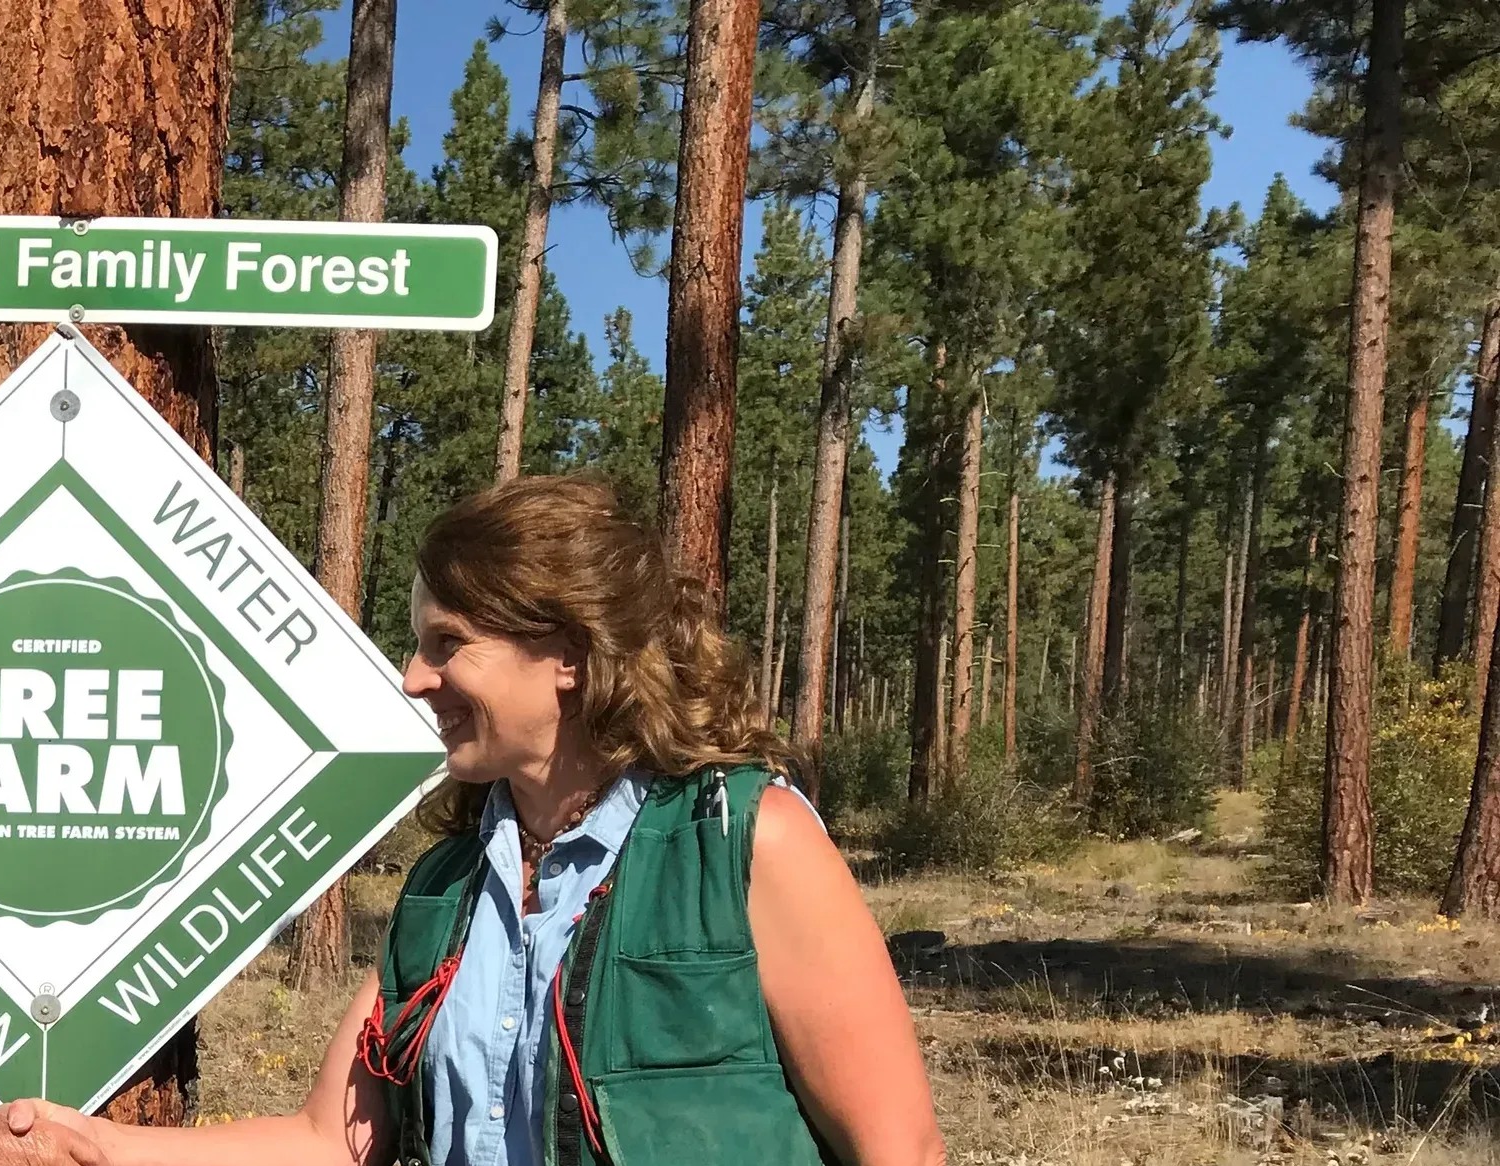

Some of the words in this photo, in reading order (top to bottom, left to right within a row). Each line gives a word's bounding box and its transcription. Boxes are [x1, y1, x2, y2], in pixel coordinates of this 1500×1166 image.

[17, 237, 207, 303] Family
[225, 241, 411, 296] Forest
[152, 479, 318, 666] WATER
[11, 638, 102, 654] CERTIFIED
[16, 824, 56, 839] TREE
[61, 825, 110, 840] FARM
[114, 825, 180, 841] SYSTEM
[97, 806, 332, 1025] WILDLIFE
